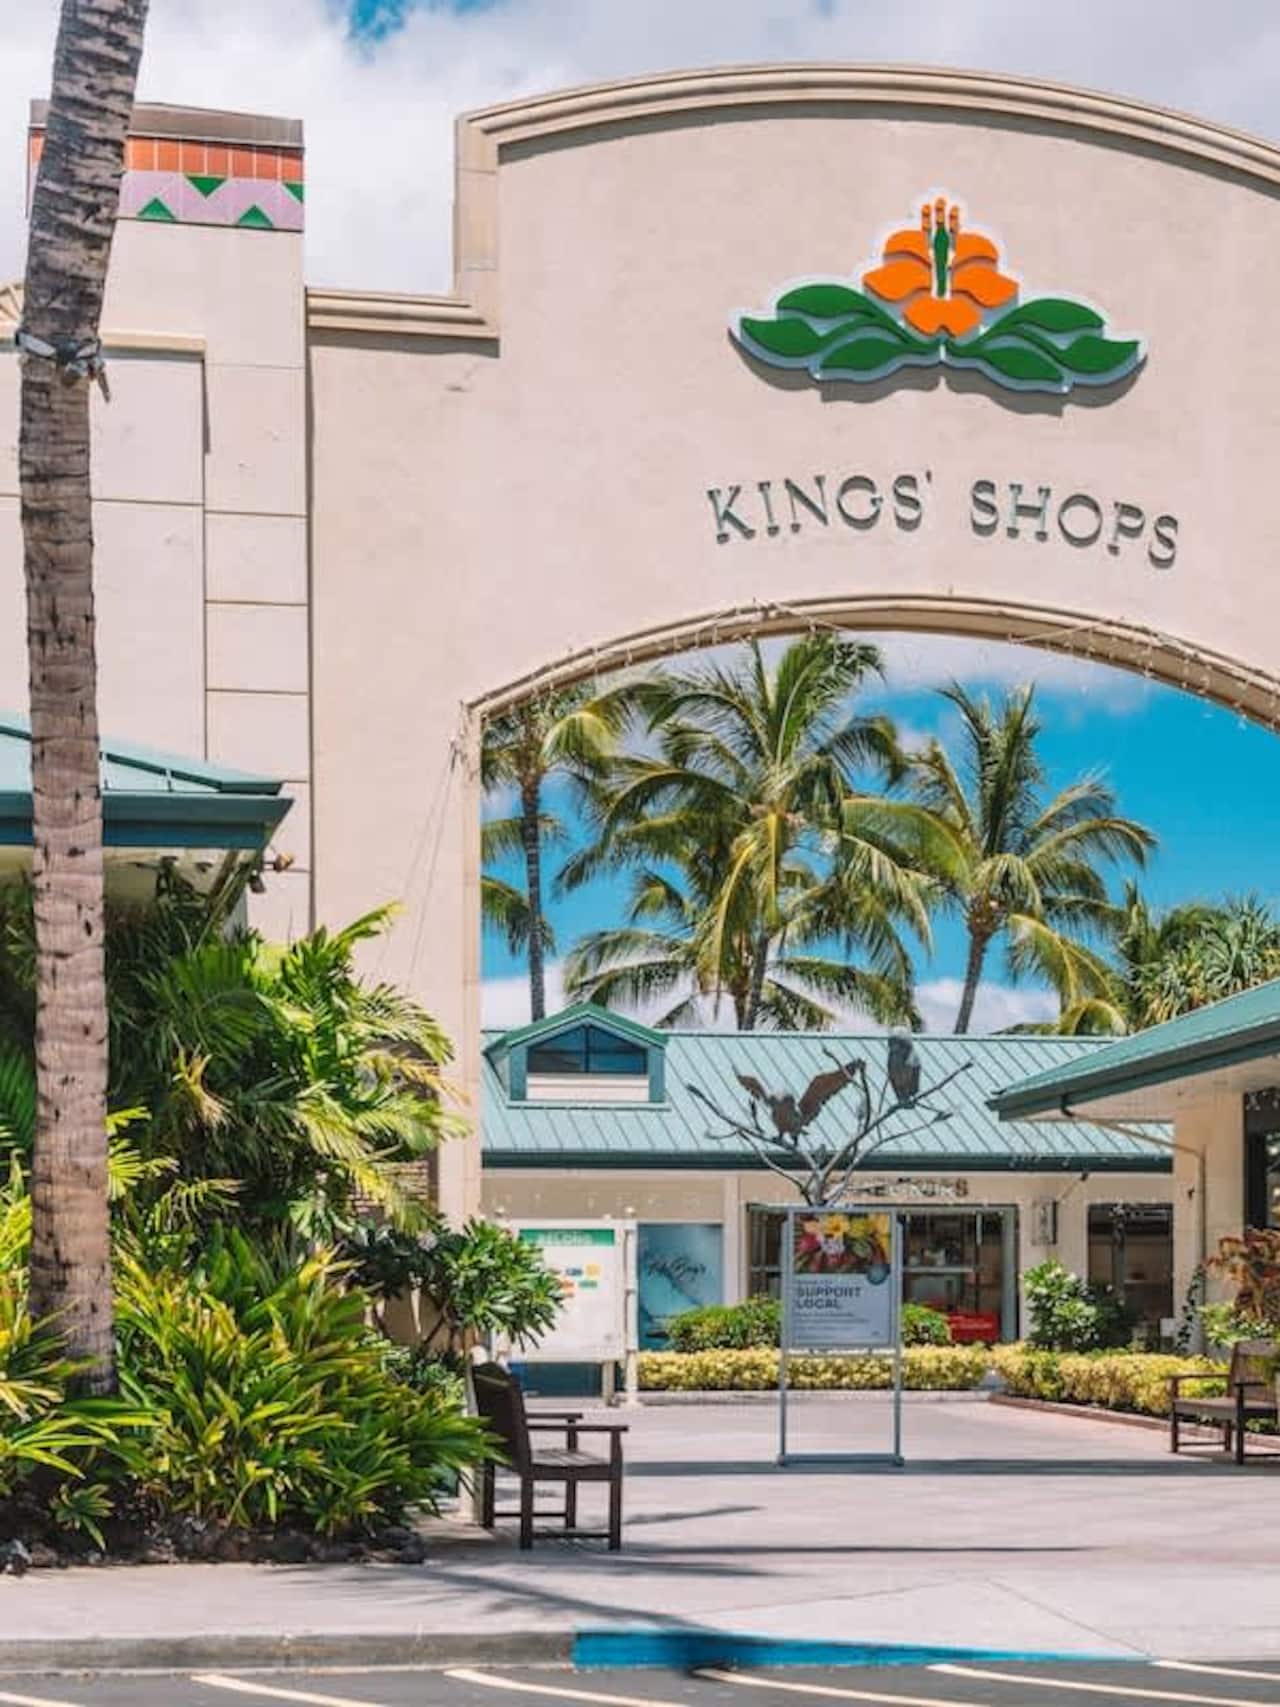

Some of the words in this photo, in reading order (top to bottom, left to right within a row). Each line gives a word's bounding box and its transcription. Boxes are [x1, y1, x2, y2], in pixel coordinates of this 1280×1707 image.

[706, 470, 933, 545] KINGS'
[970, 479, 1179, 569] SHOPS
[795, 1286, 862, 1298] SUPPORT
[795, 1298, 841, 1309] LOCAL
